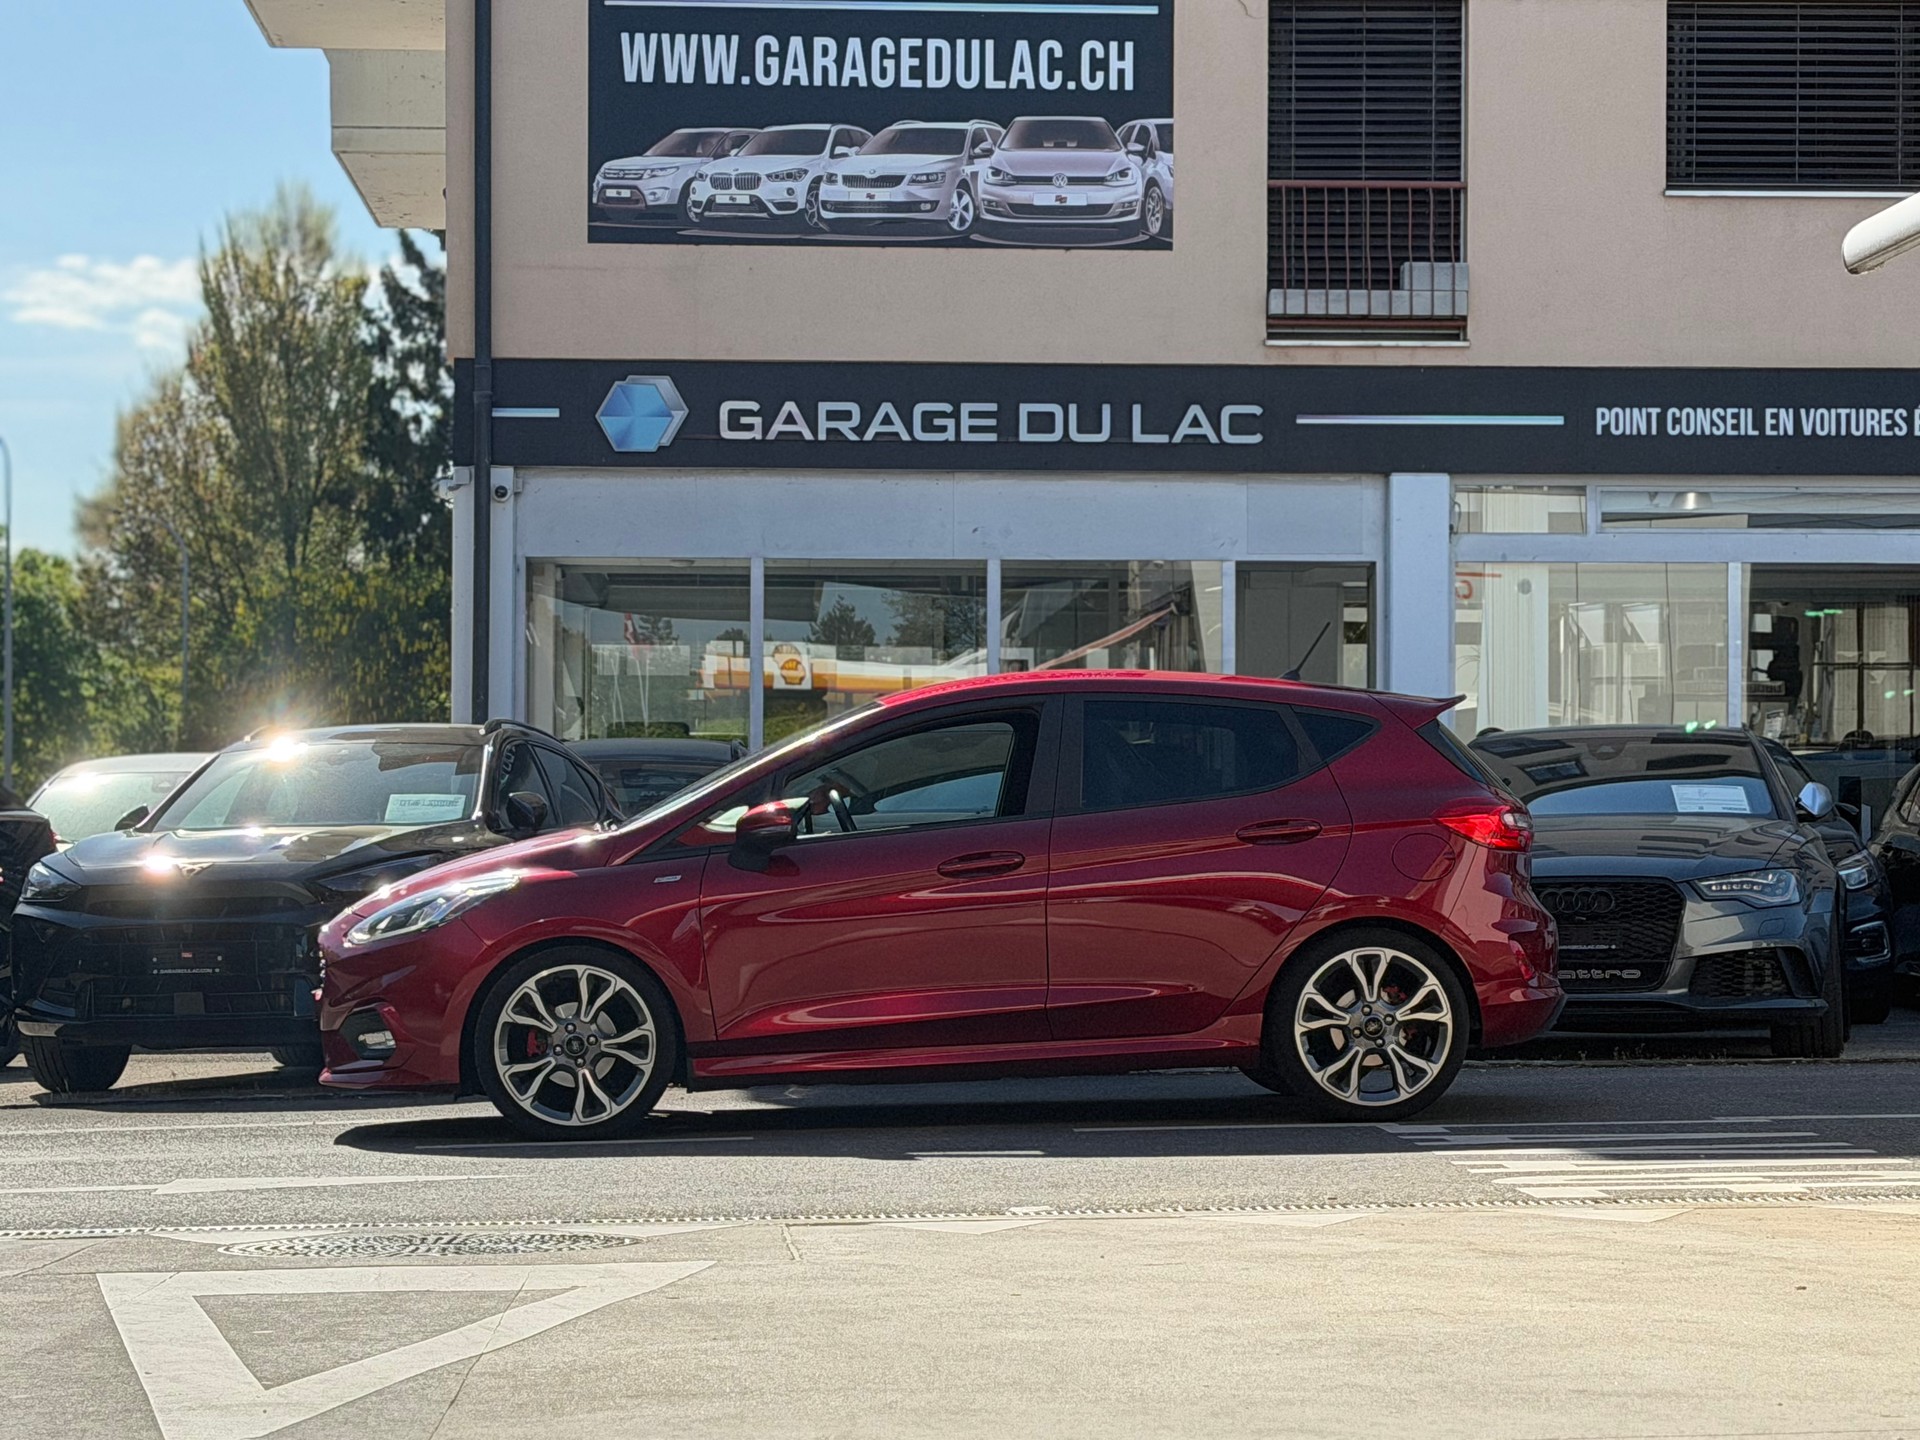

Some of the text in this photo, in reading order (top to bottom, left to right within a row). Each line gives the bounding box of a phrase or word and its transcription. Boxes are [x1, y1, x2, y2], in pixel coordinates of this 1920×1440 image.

[620, 32, 1134, 91] WWW.GARAGEDULAC.CH
[719, 400, 1264, 444] GARAGE DU LAC
[1595, 407, 1661, 436] POINT
[1666, 407, 1760, 436] CONSEIL
[1764, 407, 1794, 436] EN
[1799, 407, 1908, 437] VOITURES
[1557, 969, 1641, 979] attro
